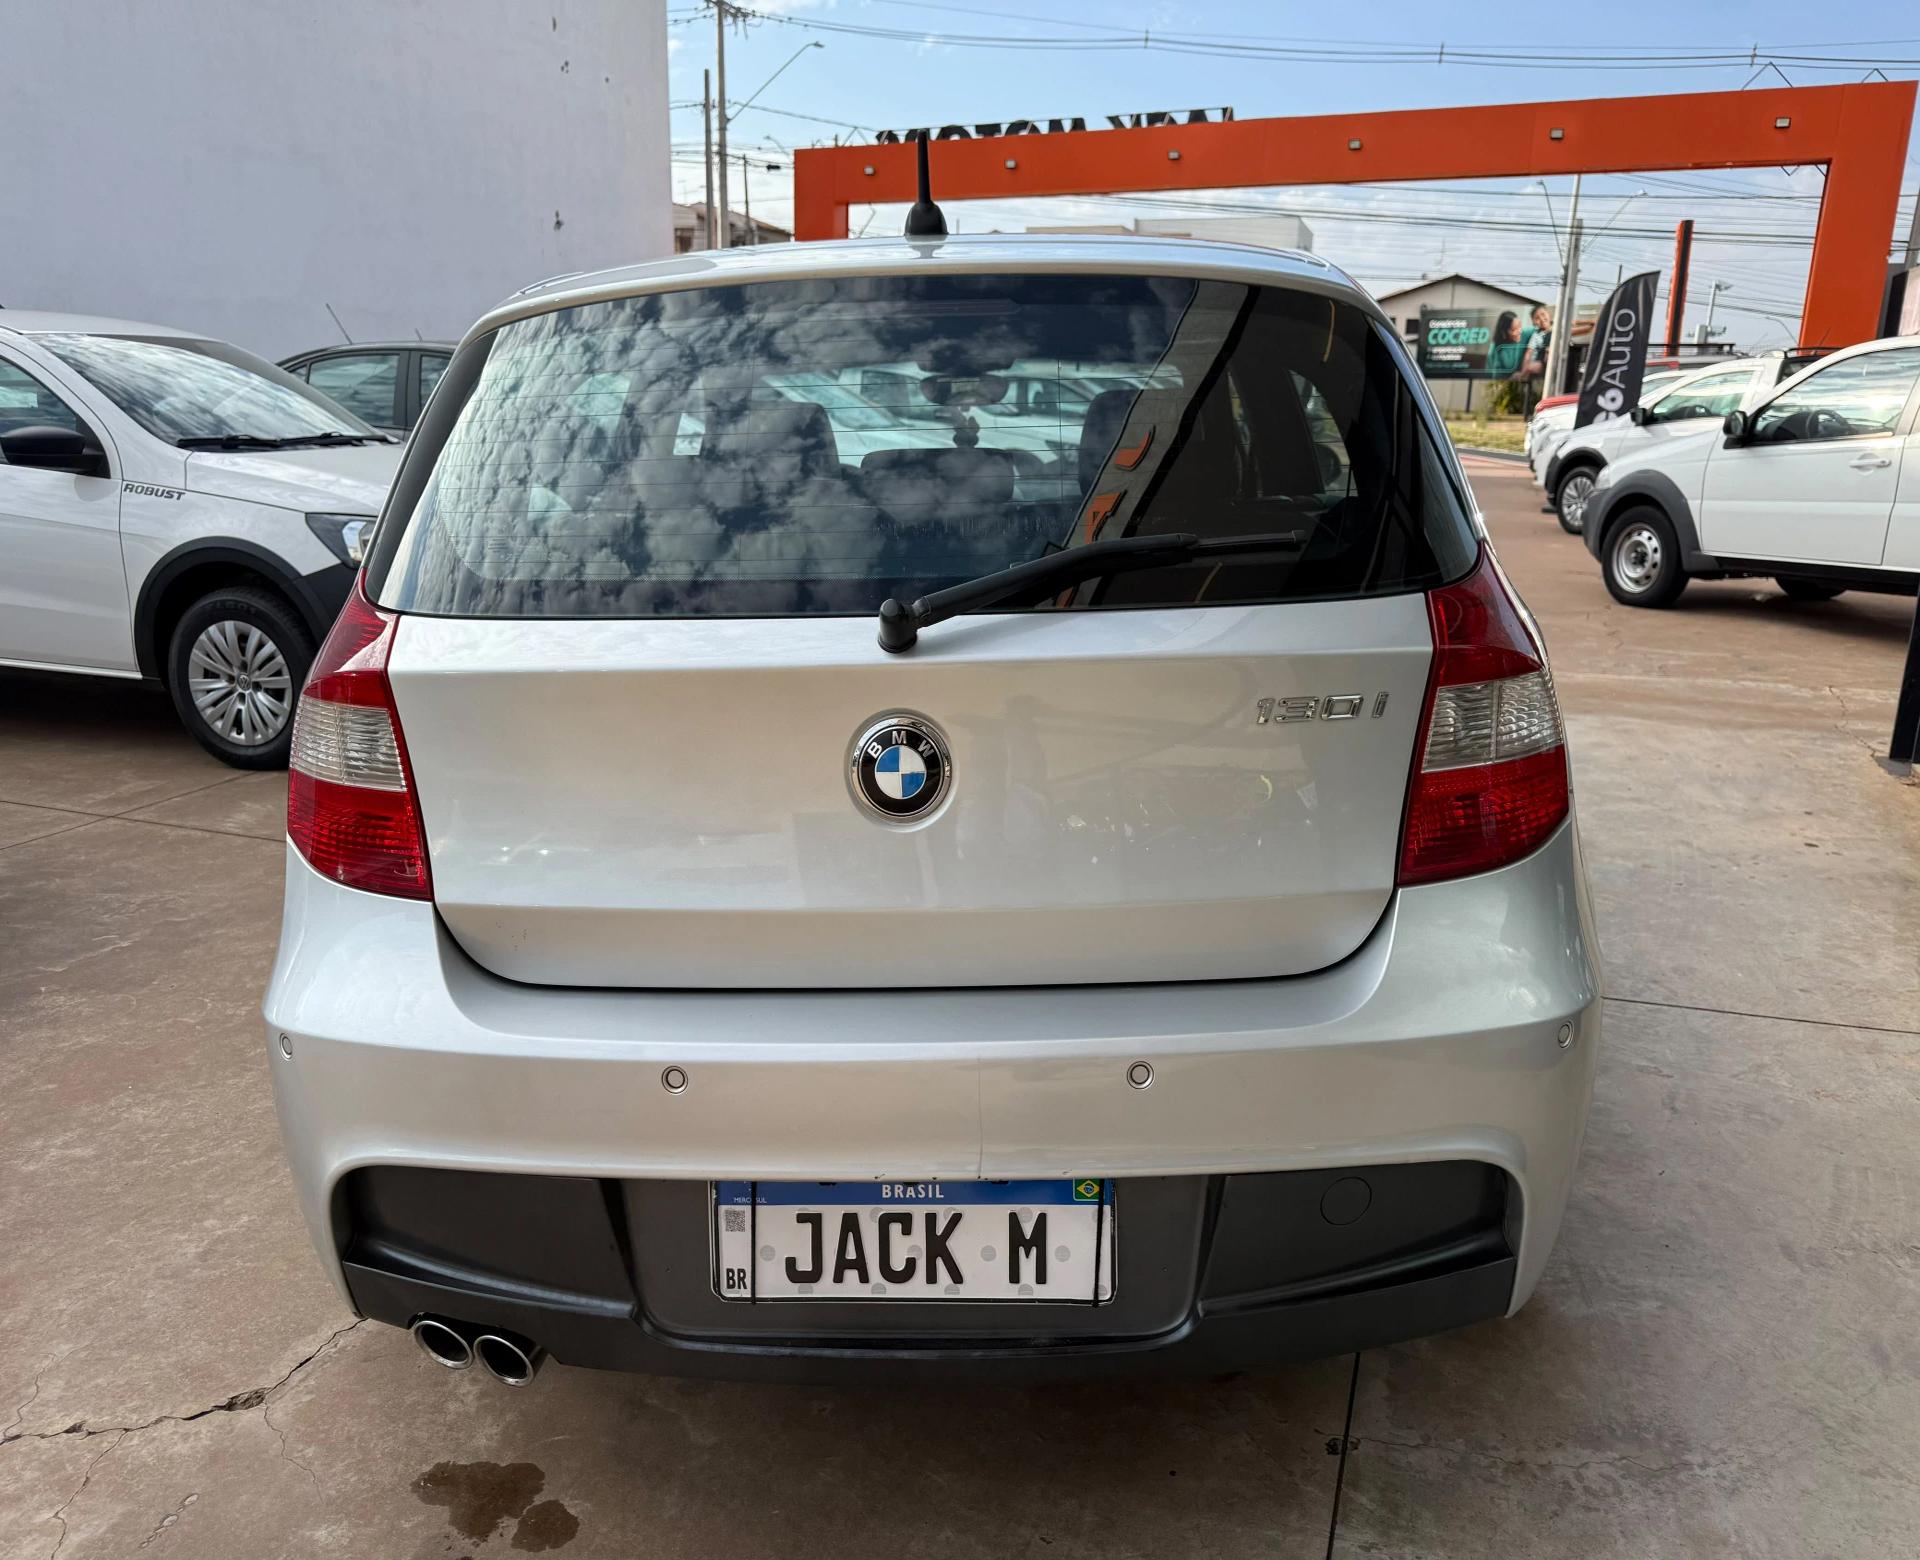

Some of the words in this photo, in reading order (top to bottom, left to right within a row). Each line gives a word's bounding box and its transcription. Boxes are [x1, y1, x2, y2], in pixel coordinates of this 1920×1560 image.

[1428, 328, 1489, 345] COCRED
[123, 483, 186, 501] ROBUST
[866, 730, 935, 759] BMW
[733, 1196, 768, 1204] MERCSUL
[881, 1184, 945, 1199] BRASIL
[785, 1212, 964, 1285] JACK
[1008, 1211, 1048, 1285] M
[726, 1267, 748, 1290] BR
